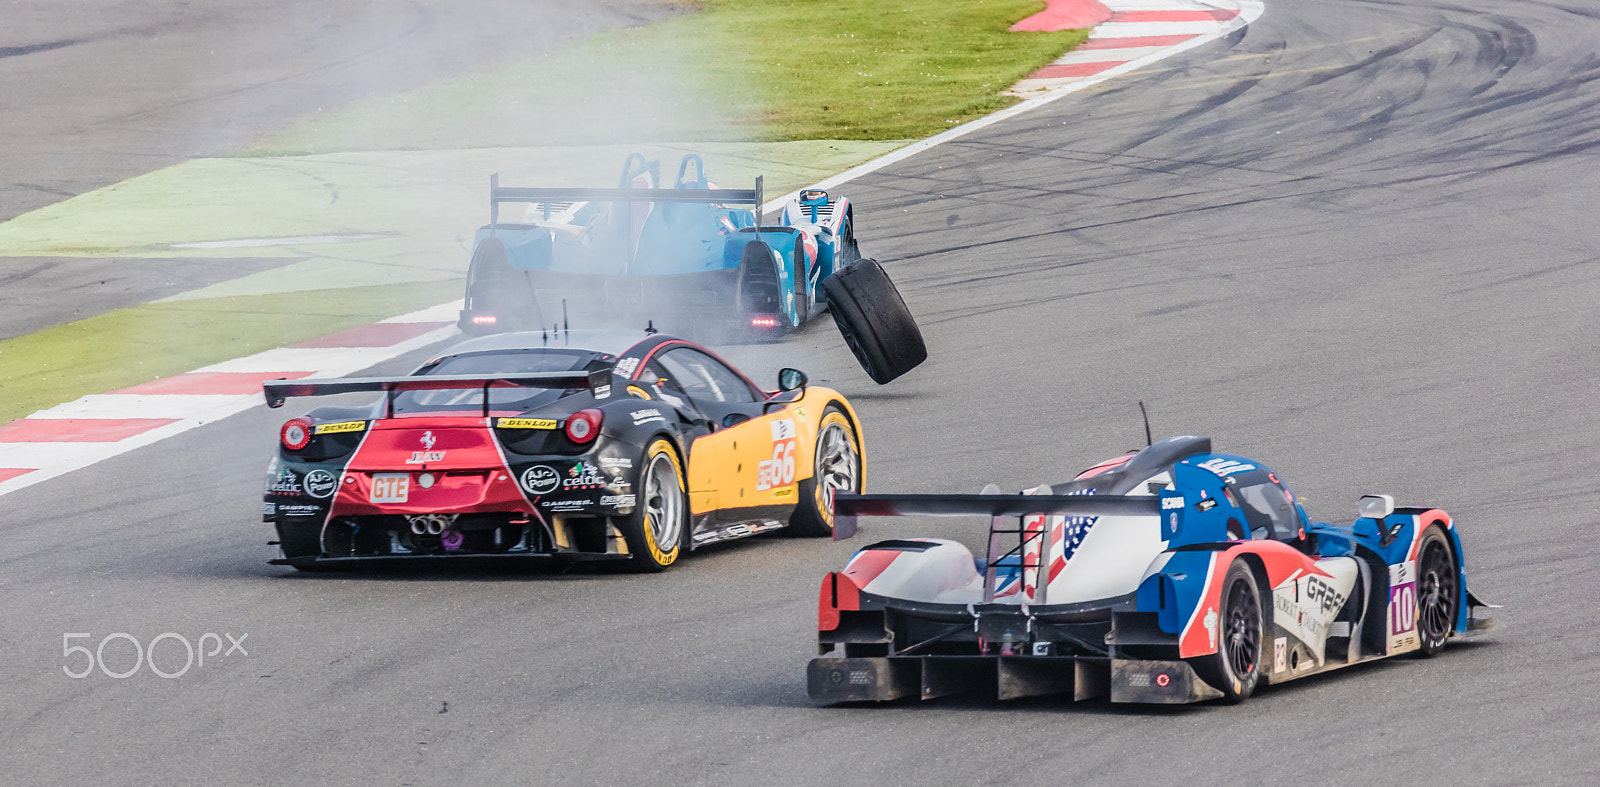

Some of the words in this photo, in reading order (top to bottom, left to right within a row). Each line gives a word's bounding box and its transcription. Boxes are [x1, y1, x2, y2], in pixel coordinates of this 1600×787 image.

[323, 422, 364, 432] DUNLOP
[508, 419, 556, 427] DUNLOP
[771, 440, 796, 486] 66
[374, 477, 408, 498] GTE
[563, 474, 605, 486] celtic
[1392, 586, 1413, 632] 10
